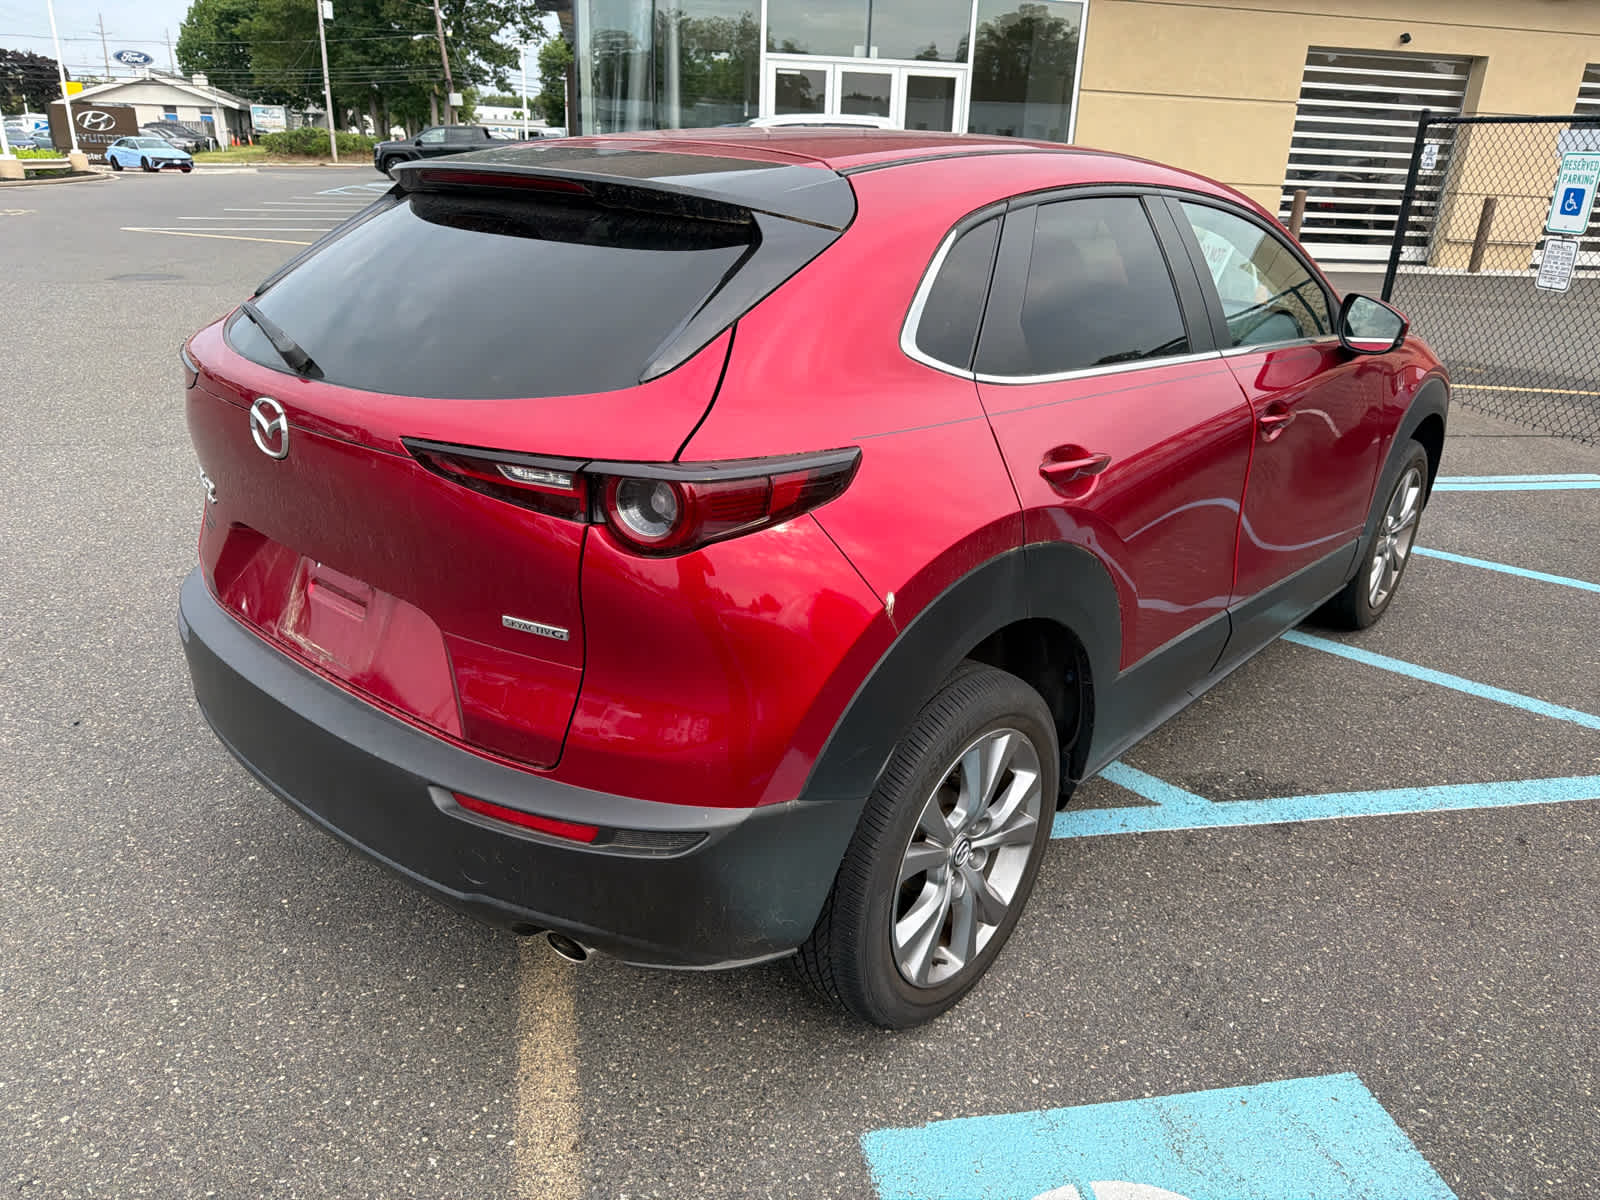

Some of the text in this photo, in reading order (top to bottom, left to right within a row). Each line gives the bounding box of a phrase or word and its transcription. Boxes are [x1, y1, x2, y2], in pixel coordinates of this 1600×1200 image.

[121, 49, 145, 63] Ford
[75, 133, 125, 144] HYUNDA
[1564, 160, 1599, 172] RESERVED
[1562, 173, 1594, 185] PARKING
